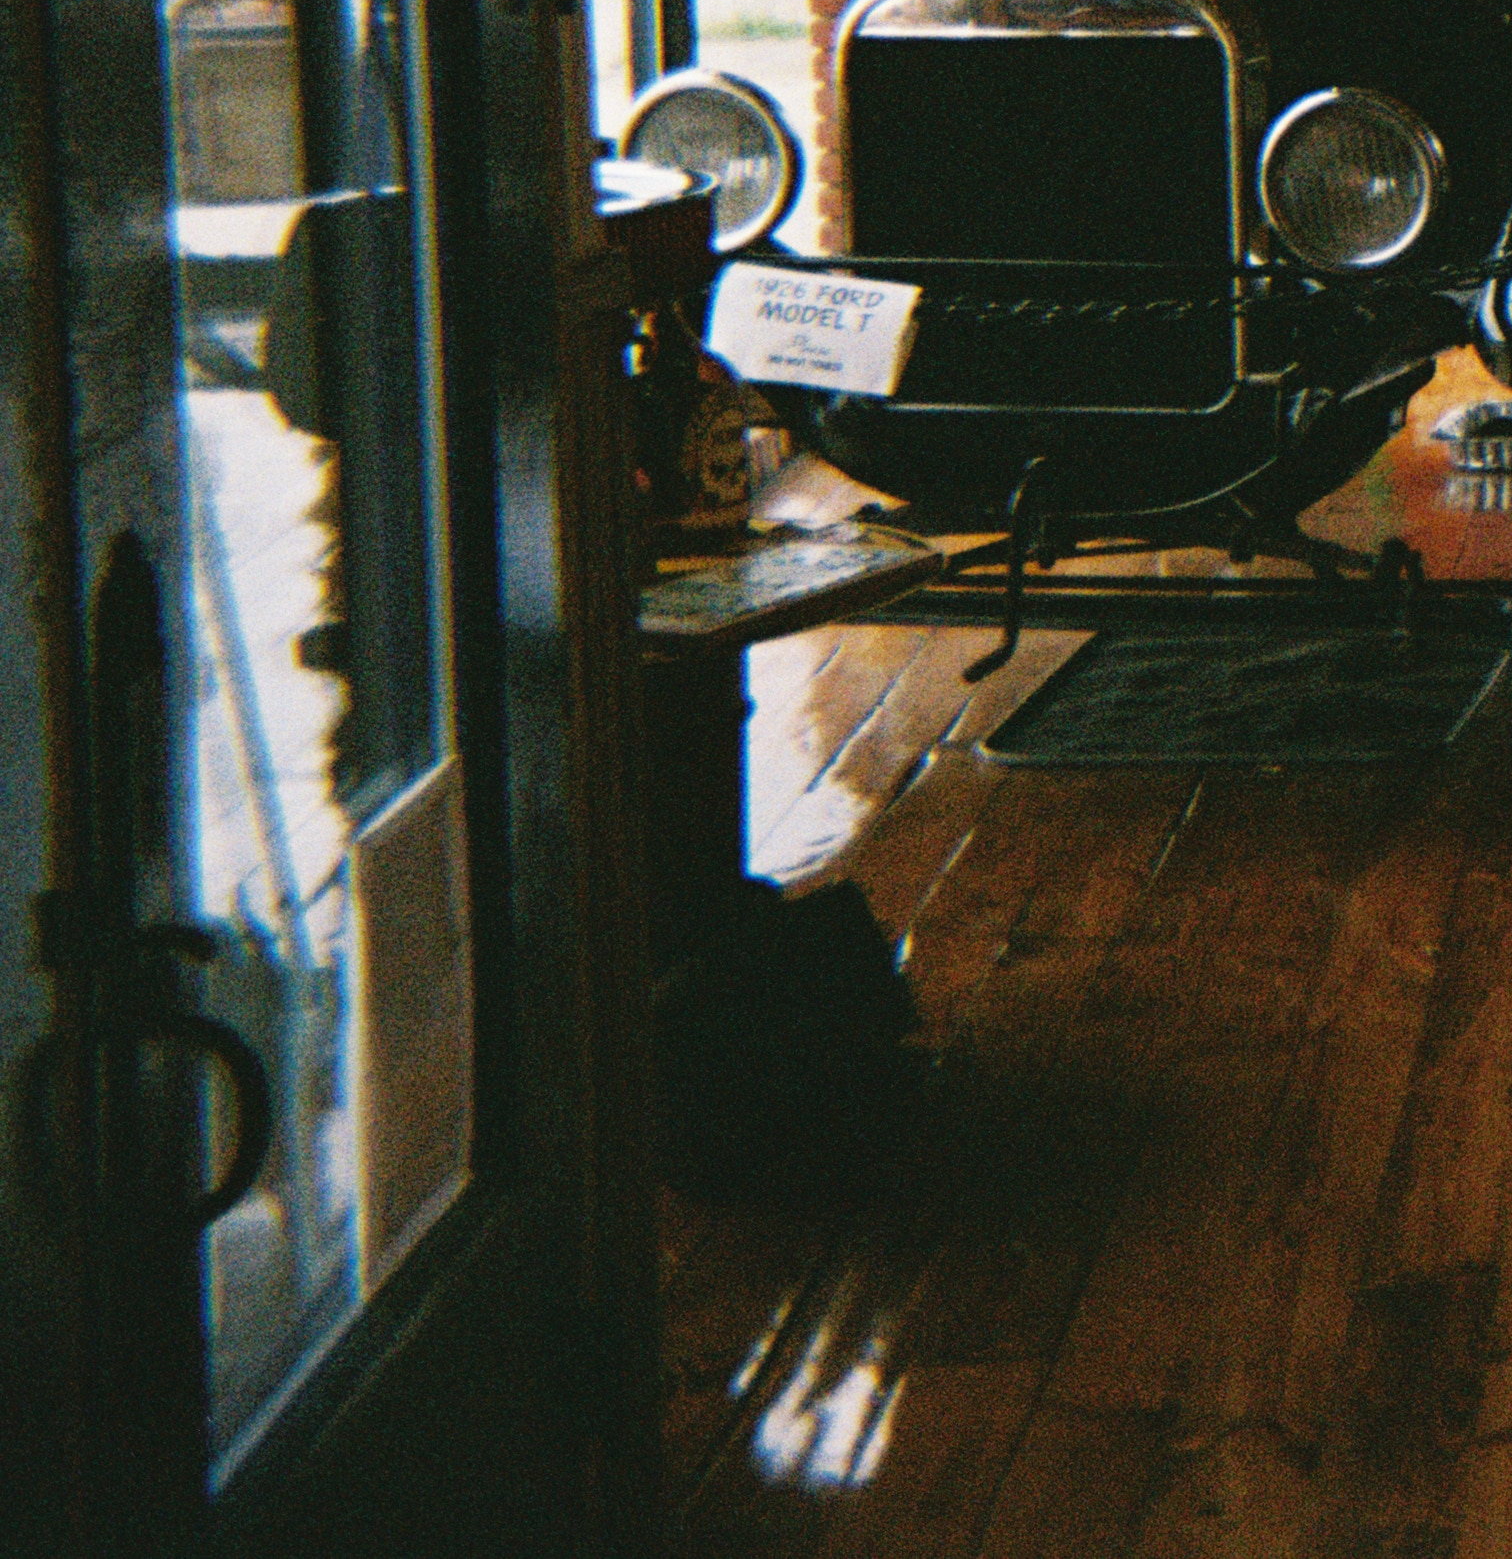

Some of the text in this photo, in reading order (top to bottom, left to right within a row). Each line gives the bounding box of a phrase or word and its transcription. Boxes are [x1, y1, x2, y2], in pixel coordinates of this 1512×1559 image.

[756, 277, 886, 309] 1926 FORD
[756, 300, 875, 332] MODEL T
